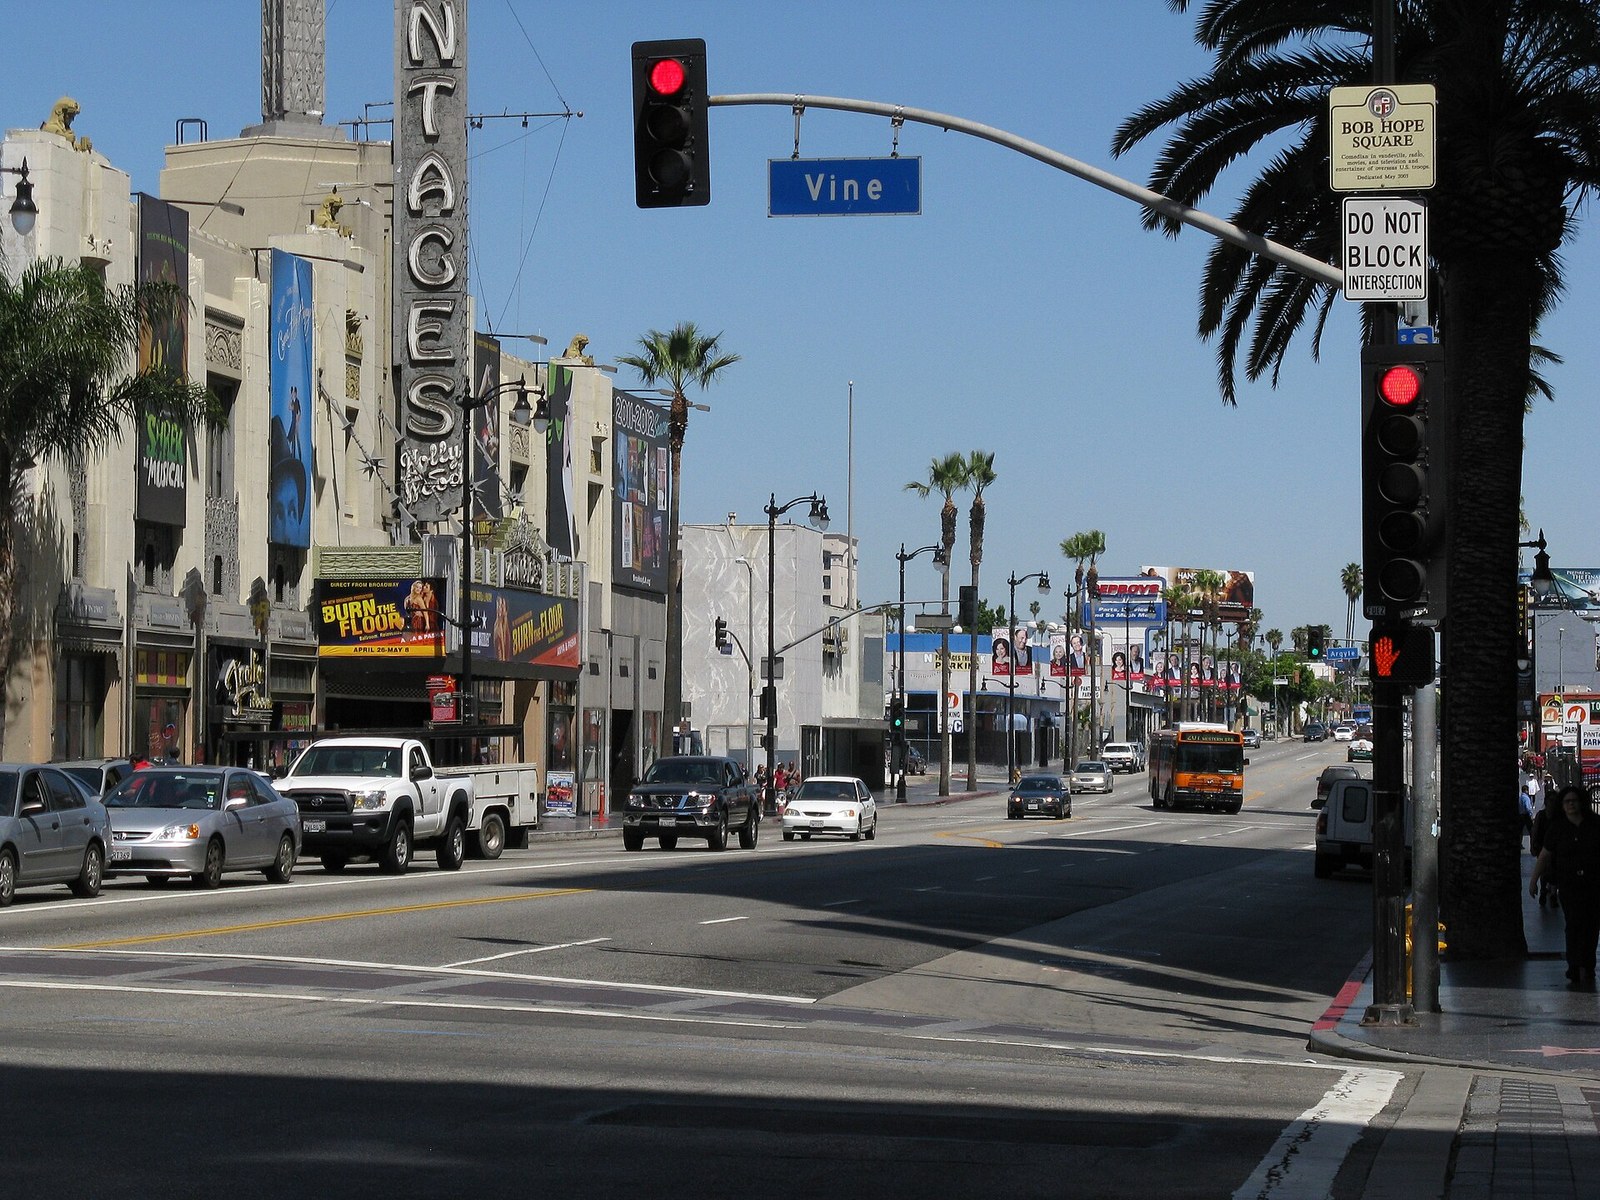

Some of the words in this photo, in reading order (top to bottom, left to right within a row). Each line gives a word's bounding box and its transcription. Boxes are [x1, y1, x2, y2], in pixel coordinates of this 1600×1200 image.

[1341, 121, 1374, 135] BOB
[1380, 119, 1425, 133] HOPE
[1352, 135, 1414, 150] SQUARE
[1408, 150, 1425, 158] radio,
[804, 173, 883, 201] Vine
[1348, 212, 1374, 235] DO
[1385, 212, 1422, 235] NOT
[1348, 245, 1422, 268] BLOCK
[1348, 274, 1422, 290] INTERSECTION
[615, 395, 656, 438] 2011-2012
[145, 413, 184, 465] SHREK
[147, 457, 185, 489] MUSICAL
[322, 598, 376, 623] BURN
[376, 602, 397, 614] THE
[339, 612, 402, 638] FLOOR
[512, 619, 533, 656] BURN
[540, 602, 563, 639] FLOOR
[1330, 650, 1355, 659] Argyle
